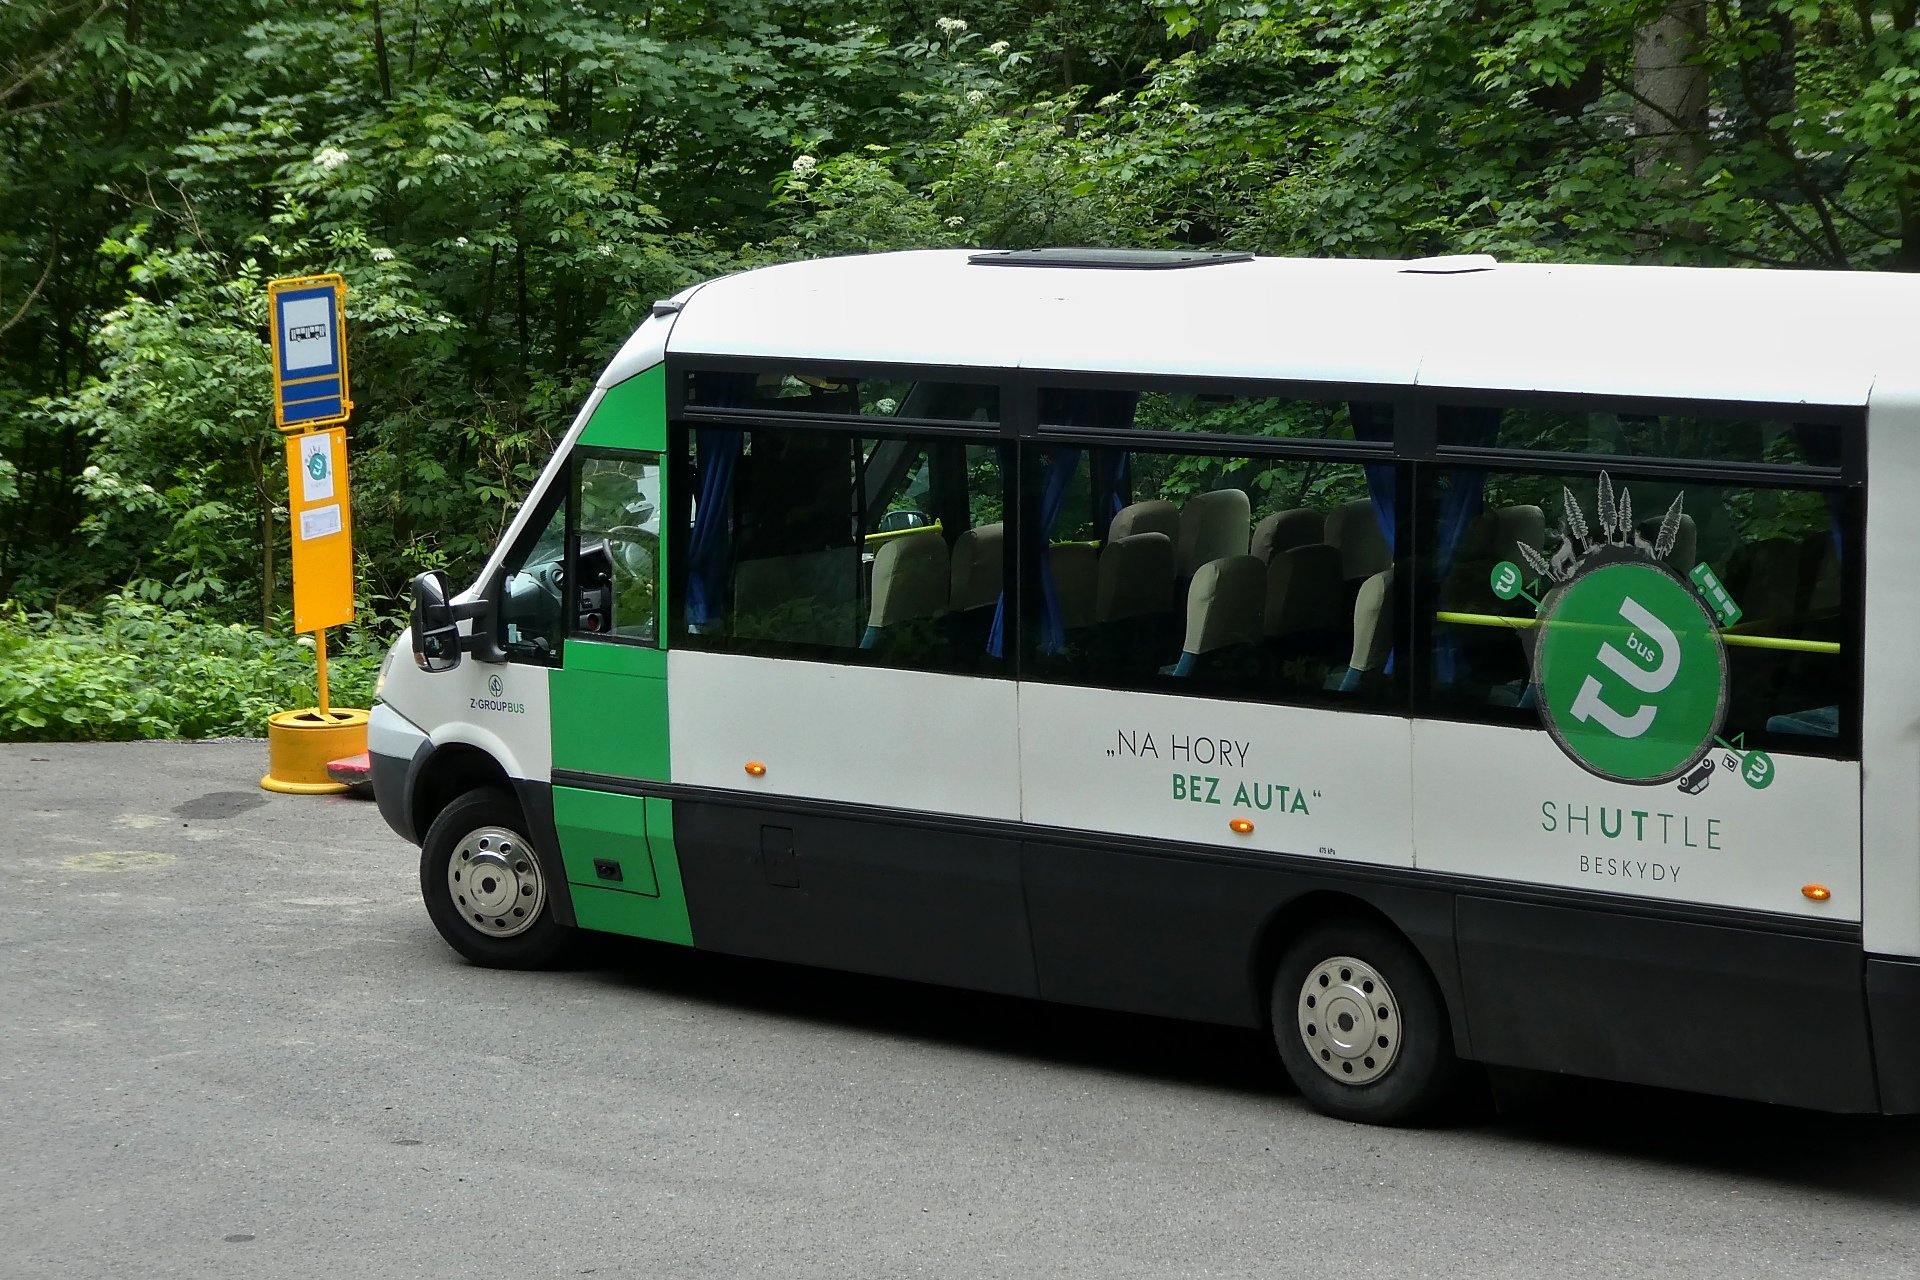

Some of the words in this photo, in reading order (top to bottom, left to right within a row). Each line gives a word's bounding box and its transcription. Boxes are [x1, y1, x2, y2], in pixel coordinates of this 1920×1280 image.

[1625, 632, 1656, 663] bus
[1172, 734, 1250, 768] HORY
[1172, 773, 1221, 805] BEZ
[1542, 801, 1722, 851] SHUTTLE
[1580, 855, 1681, 883] BESKYDY
